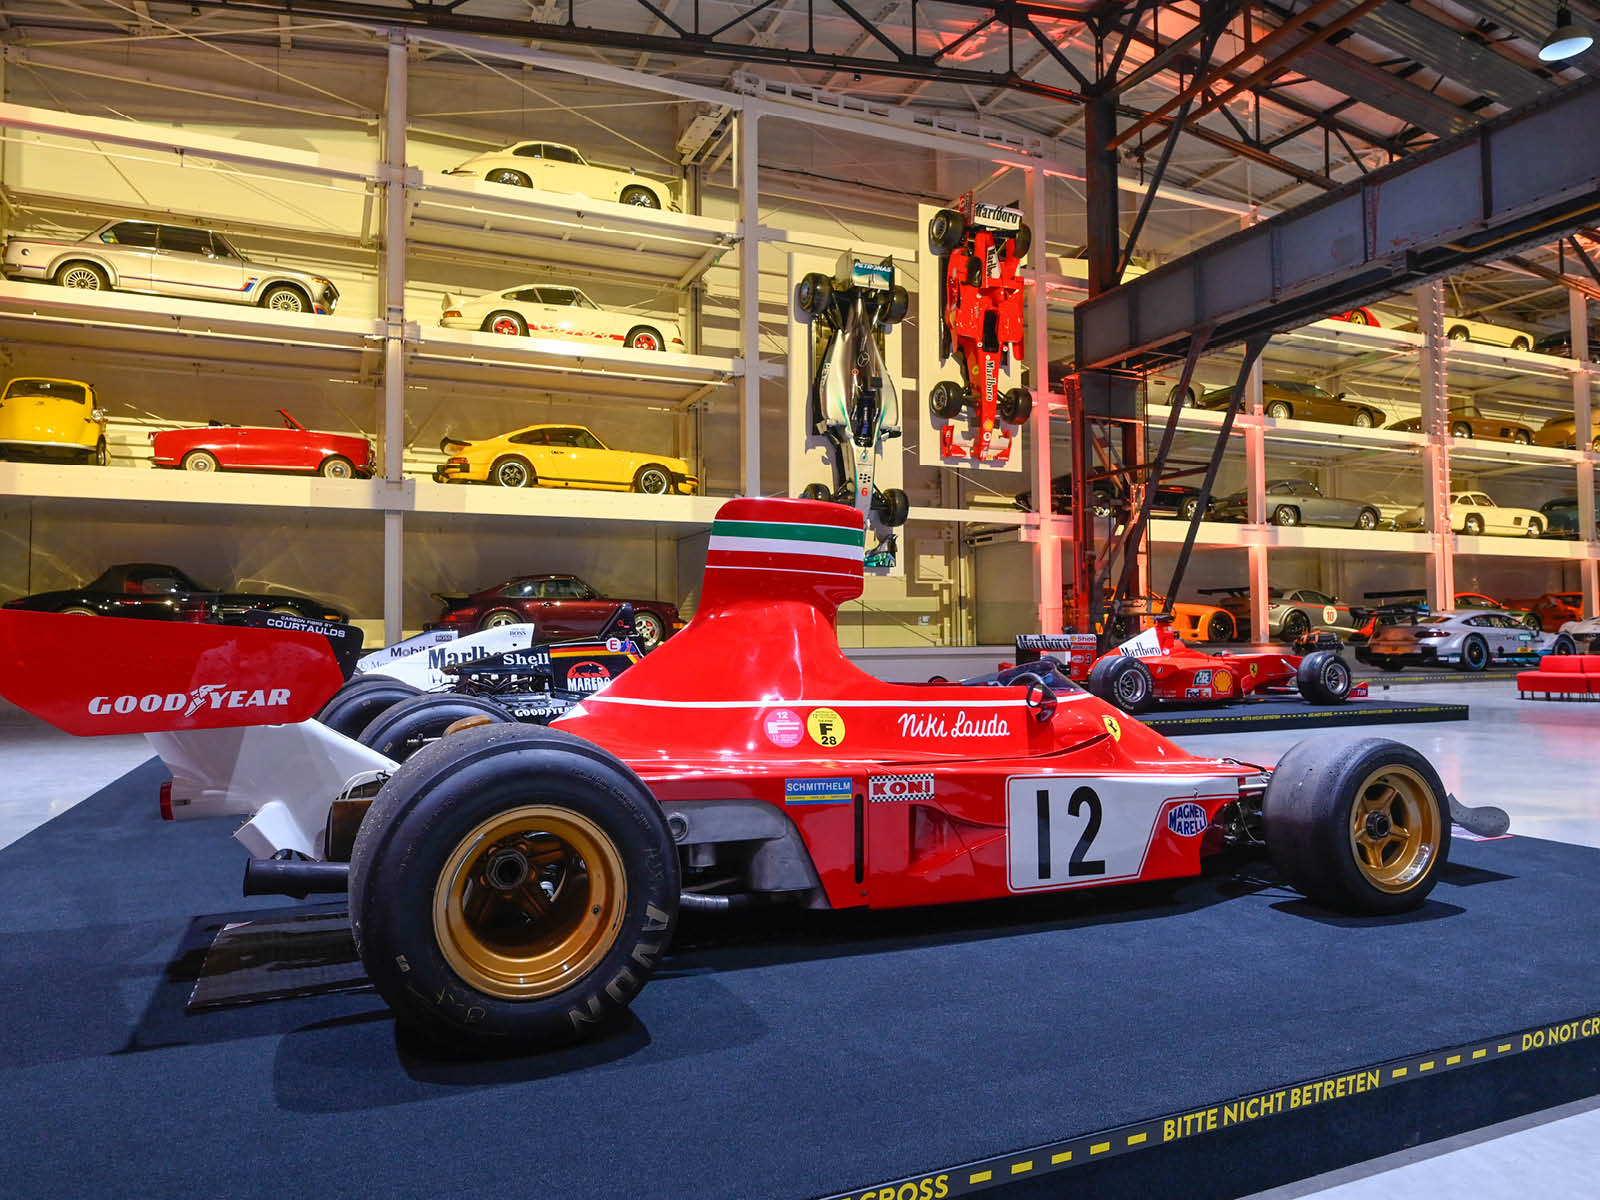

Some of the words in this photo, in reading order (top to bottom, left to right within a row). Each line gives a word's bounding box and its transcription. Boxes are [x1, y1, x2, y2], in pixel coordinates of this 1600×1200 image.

[854, 262, 892, 272] PETRONAS
[861, 487, 868, 497] 6
[281, 615, 305, 624] CARBON
[266, 618, 346, 638] COURTAULDS
[609, 639, 618, 650] E
[1018, 635, 1071, 650] Marlboro
[1120, 642, 1161, 657] Marlboro
[503, 653, 550, 665] Shell
[88, 684, 291, 717] GOODYEAR
[776, 711, 789, 719] 12
[819, 723, 834, 735] F
[898, 713, 948, 738] Niki
[950, 711, 1011, 738] Lauda
[821, 736, 837, 745] 28
[786, 781, 850, 792] SCHMITTHELM
[872, 780, 930, 796] KONI
[1036, 785, 1106, 880] 12
[1521, 1030, 1545, 1052] DO
[1548, 1021, 1579, 1046] NOT
[1581, 1017, 1600, 1037] CR
[1163, 1107, 1218, 1142] BITTE
[1223, 1091, 1286, 1126] NICHT
[1290, 1069, 1381, 1110] BETRETEN
